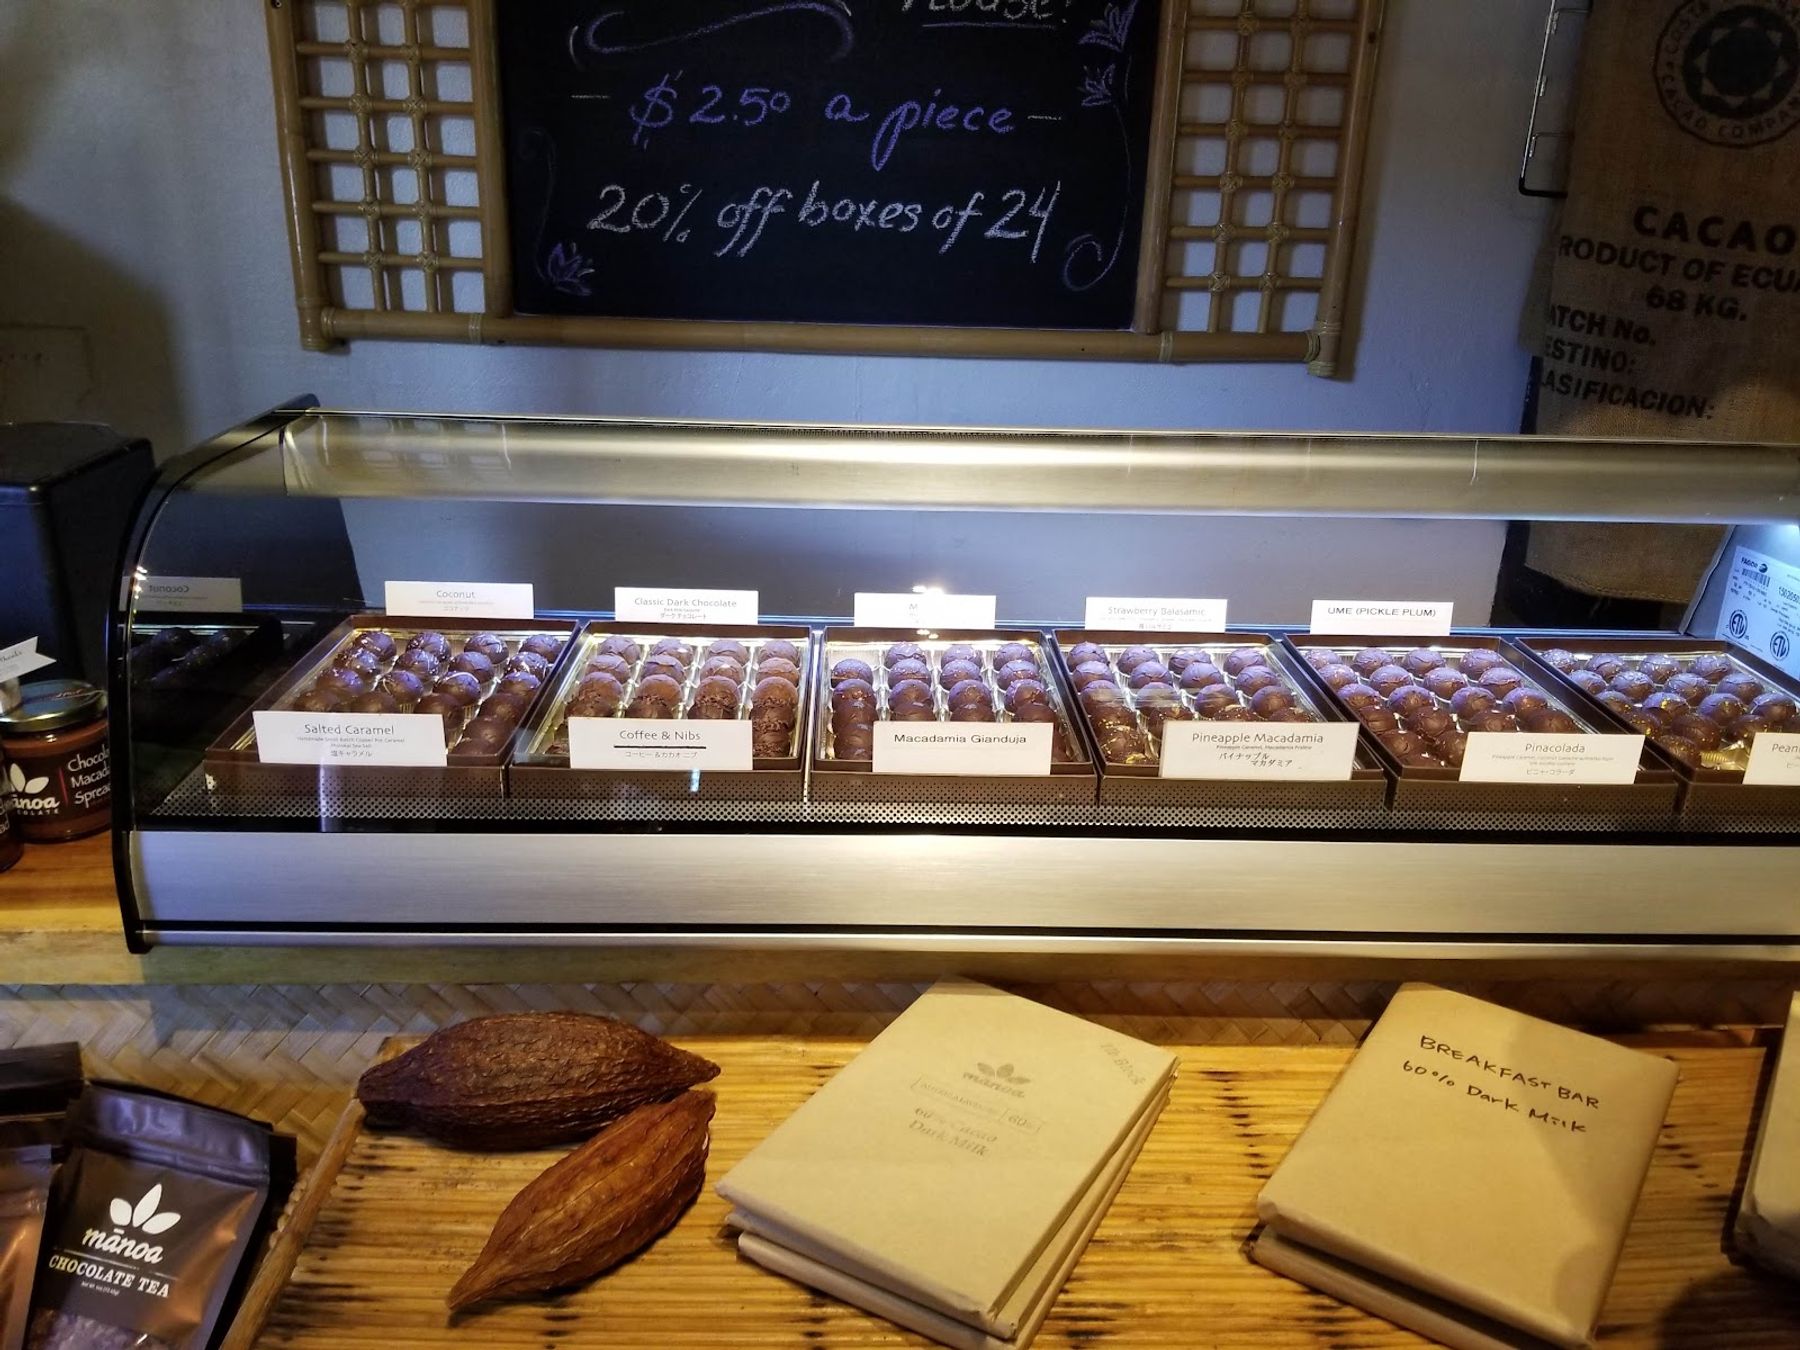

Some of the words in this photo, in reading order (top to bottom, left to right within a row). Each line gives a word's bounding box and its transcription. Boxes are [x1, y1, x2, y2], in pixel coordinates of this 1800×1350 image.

[825, 93, 869, 121] a
[873, 90, 1013, 171] piece
[587, 181, 703, 243] 20%
[715, 186, 792, 257] off
[799, 180, 922, 232] boxes
[933, 191, 982, 254] of
[984, 180, 1061, 263] 24
[1633, 206, 1798, 256] CACAO
[1683, 258, 1726, 282] OF
[1646, 284, 1687, 312] 68
[1694, 292, 1747, 322] KG.
[436, 589, 476, 600] Coconut
[634, 597, 665, 606] Classic
[667, 598, 689, 607] Dark
[691, 599, 737, 608] Chocolate
[1107, 606, 1158, 616] Strawberry
[1327, 607, 1353, 615] UME
[1355, 607, 1399, 616] (PICKLE
[1402, 608, 1437, 617] PLUM)
[304, 723, 341, 735] Salted
[345, 724, 395, 736] Caramel
[619, 729, 658, 741] Coffee
[661, 730, 671, 741] &
[674, 730, 702, 742] Nibs
[893, 734, 967, 744] Macadamia
[970, 734, 1027, 745] Gianduja
[1192, 732, 1251, 745] Pineapple
[1253, 732, 1324, 744] Macadamia
[1525, 743, 1586, 753] Pinacolada
[1771, 743, 1800, 753] Pean
[1419, 1034, 1552, 1089] BREAKFAST
[1556, 1085, 1600, 1110] BAR
[1402, 1059, 1455, 1087] 60%
[1466, 1084, 1519, 1112] Dark
[81, 1227, 164, 1264] mānoa
[48, 1254, 136, 1288] CHOCOLATE
[137, 1276, 171, 1299] TEA
